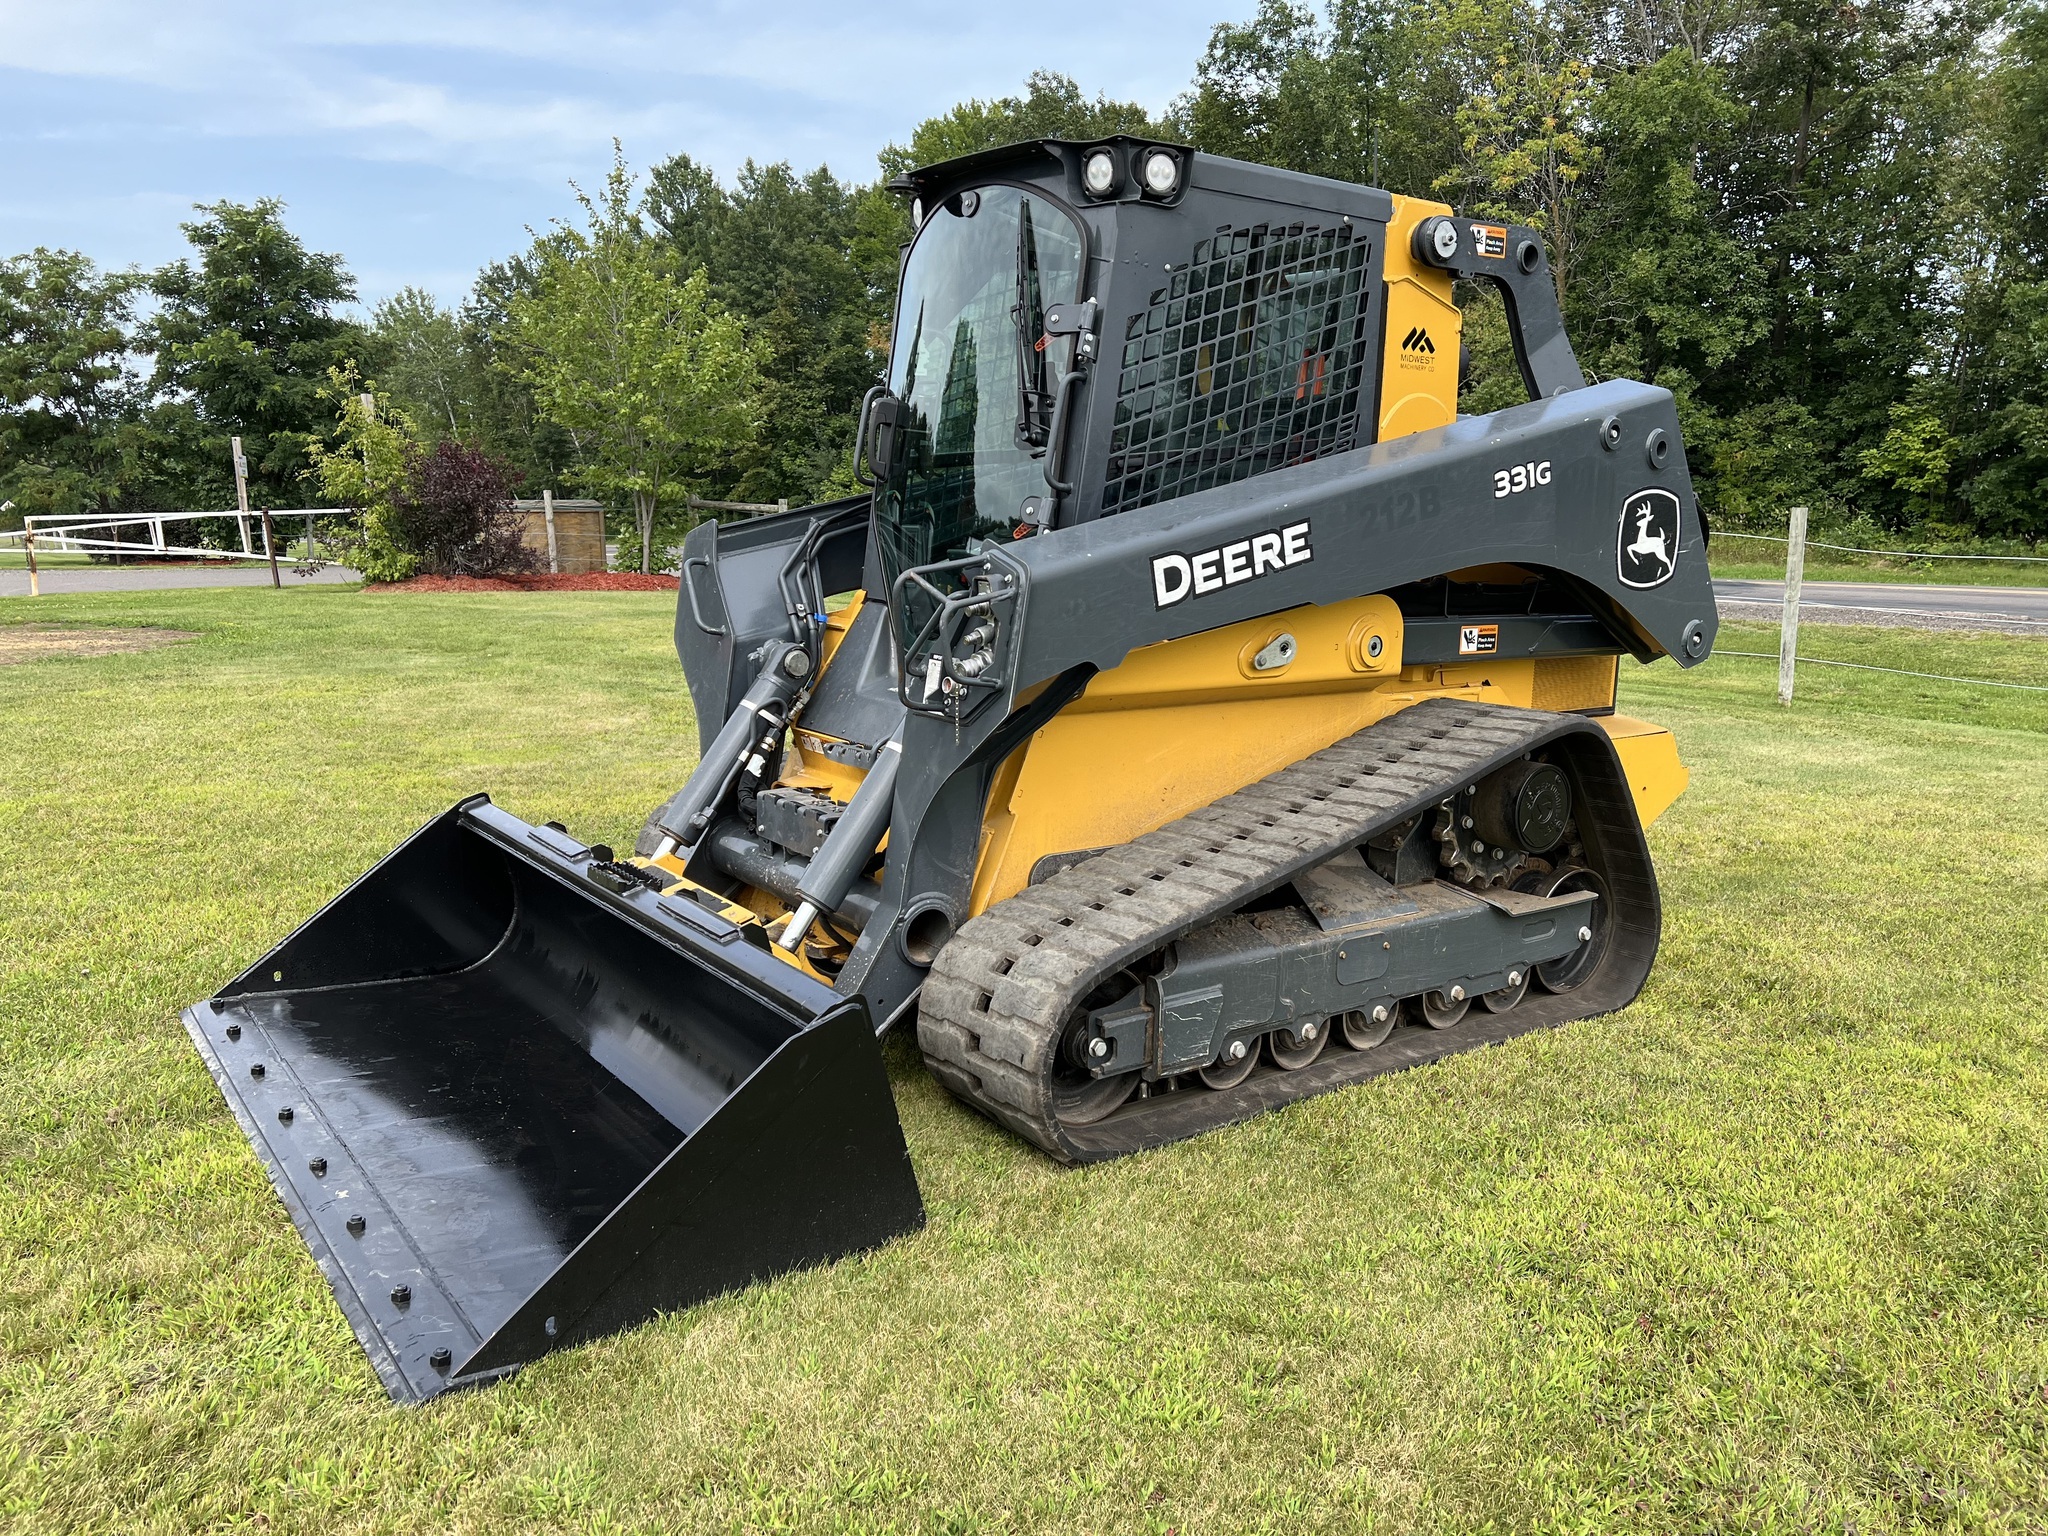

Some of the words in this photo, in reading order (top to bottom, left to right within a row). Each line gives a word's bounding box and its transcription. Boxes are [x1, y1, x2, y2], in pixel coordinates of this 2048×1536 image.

[1493, 460, 1552, 499] 331G
[1360, 485, 1442, 538] 212B
[1152, 520, 1312, 608] DEERE
